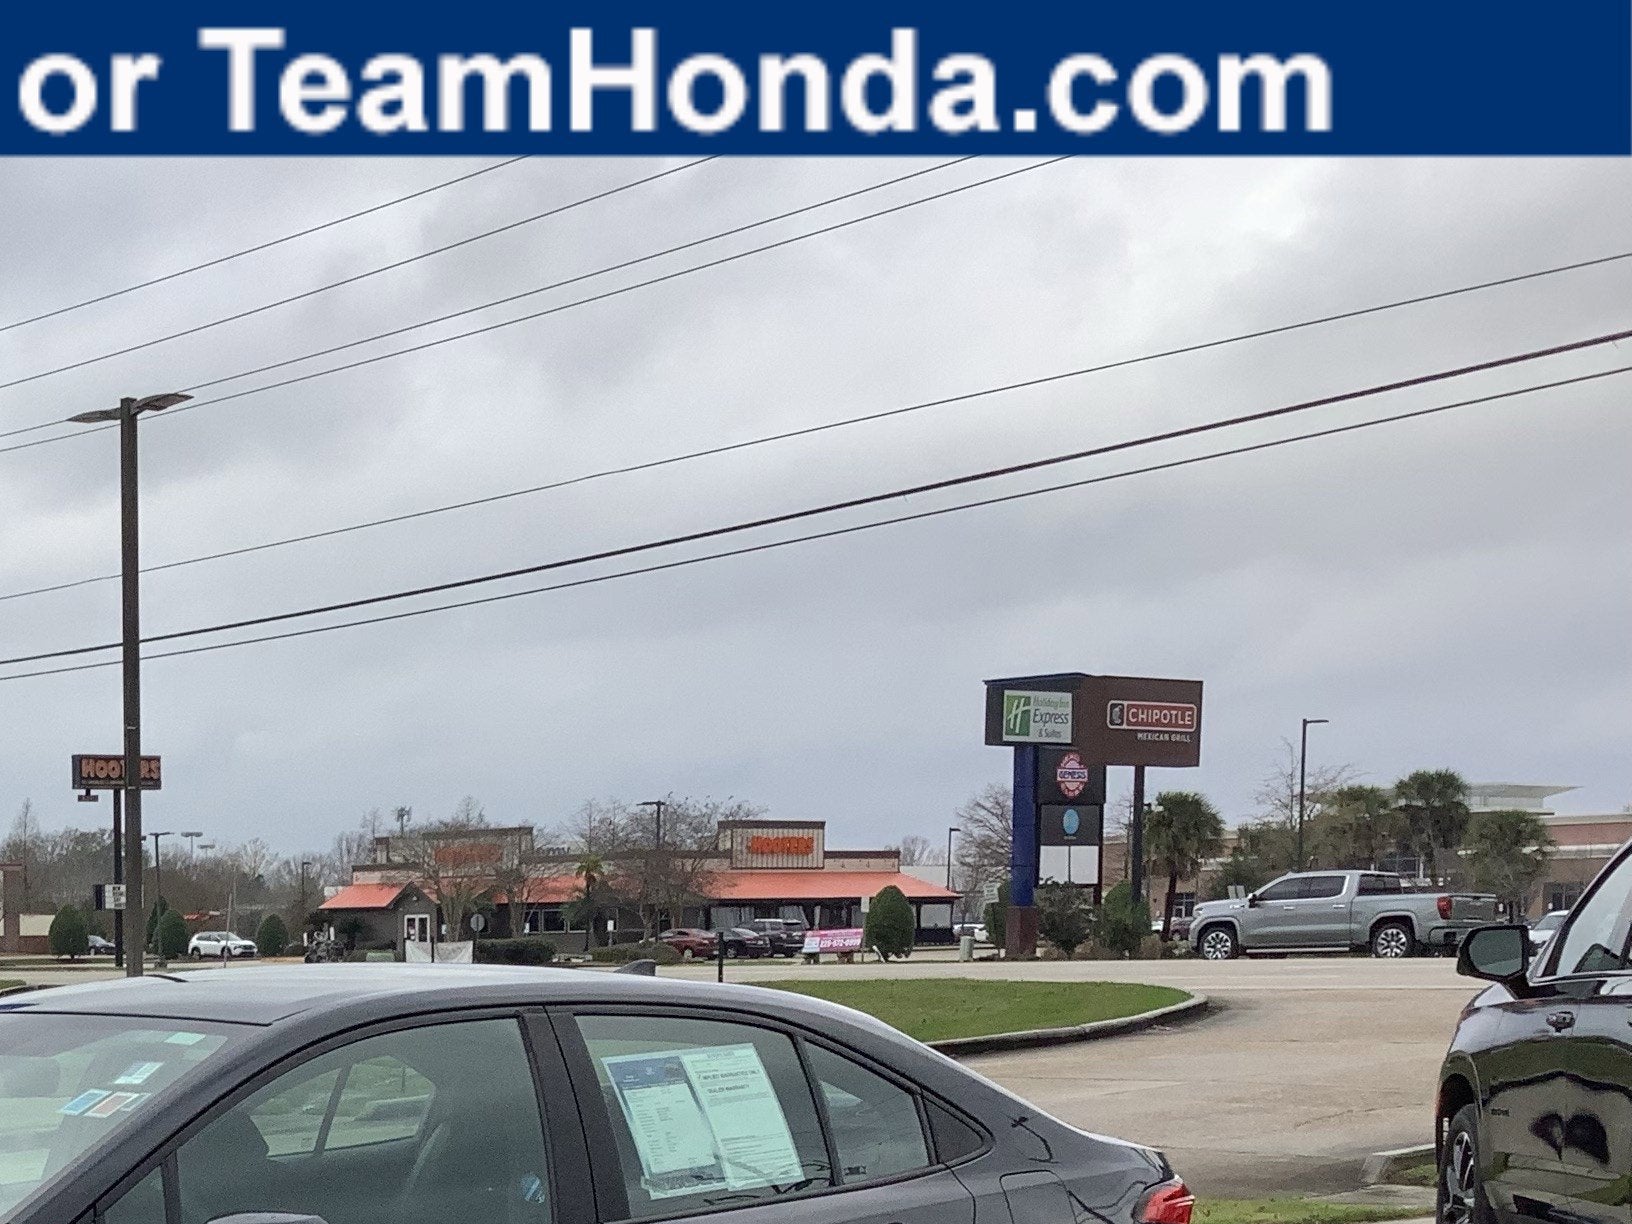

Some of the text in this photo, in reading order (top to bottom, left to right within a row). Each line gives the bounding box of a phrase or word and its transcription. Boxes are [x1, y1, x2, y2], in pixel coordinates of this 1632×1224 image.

[1032, 708, 1069, 727] Express
[1128, 707, 1193, 726] CHIPOTLE
[1044, 729, 1062, 739] Suites
[1137, 732, 1191, 743] MEXICAN GRILL
[81, 758, 159, 780] HOORS
[1058, 770, 1087, 780] GENESIS
